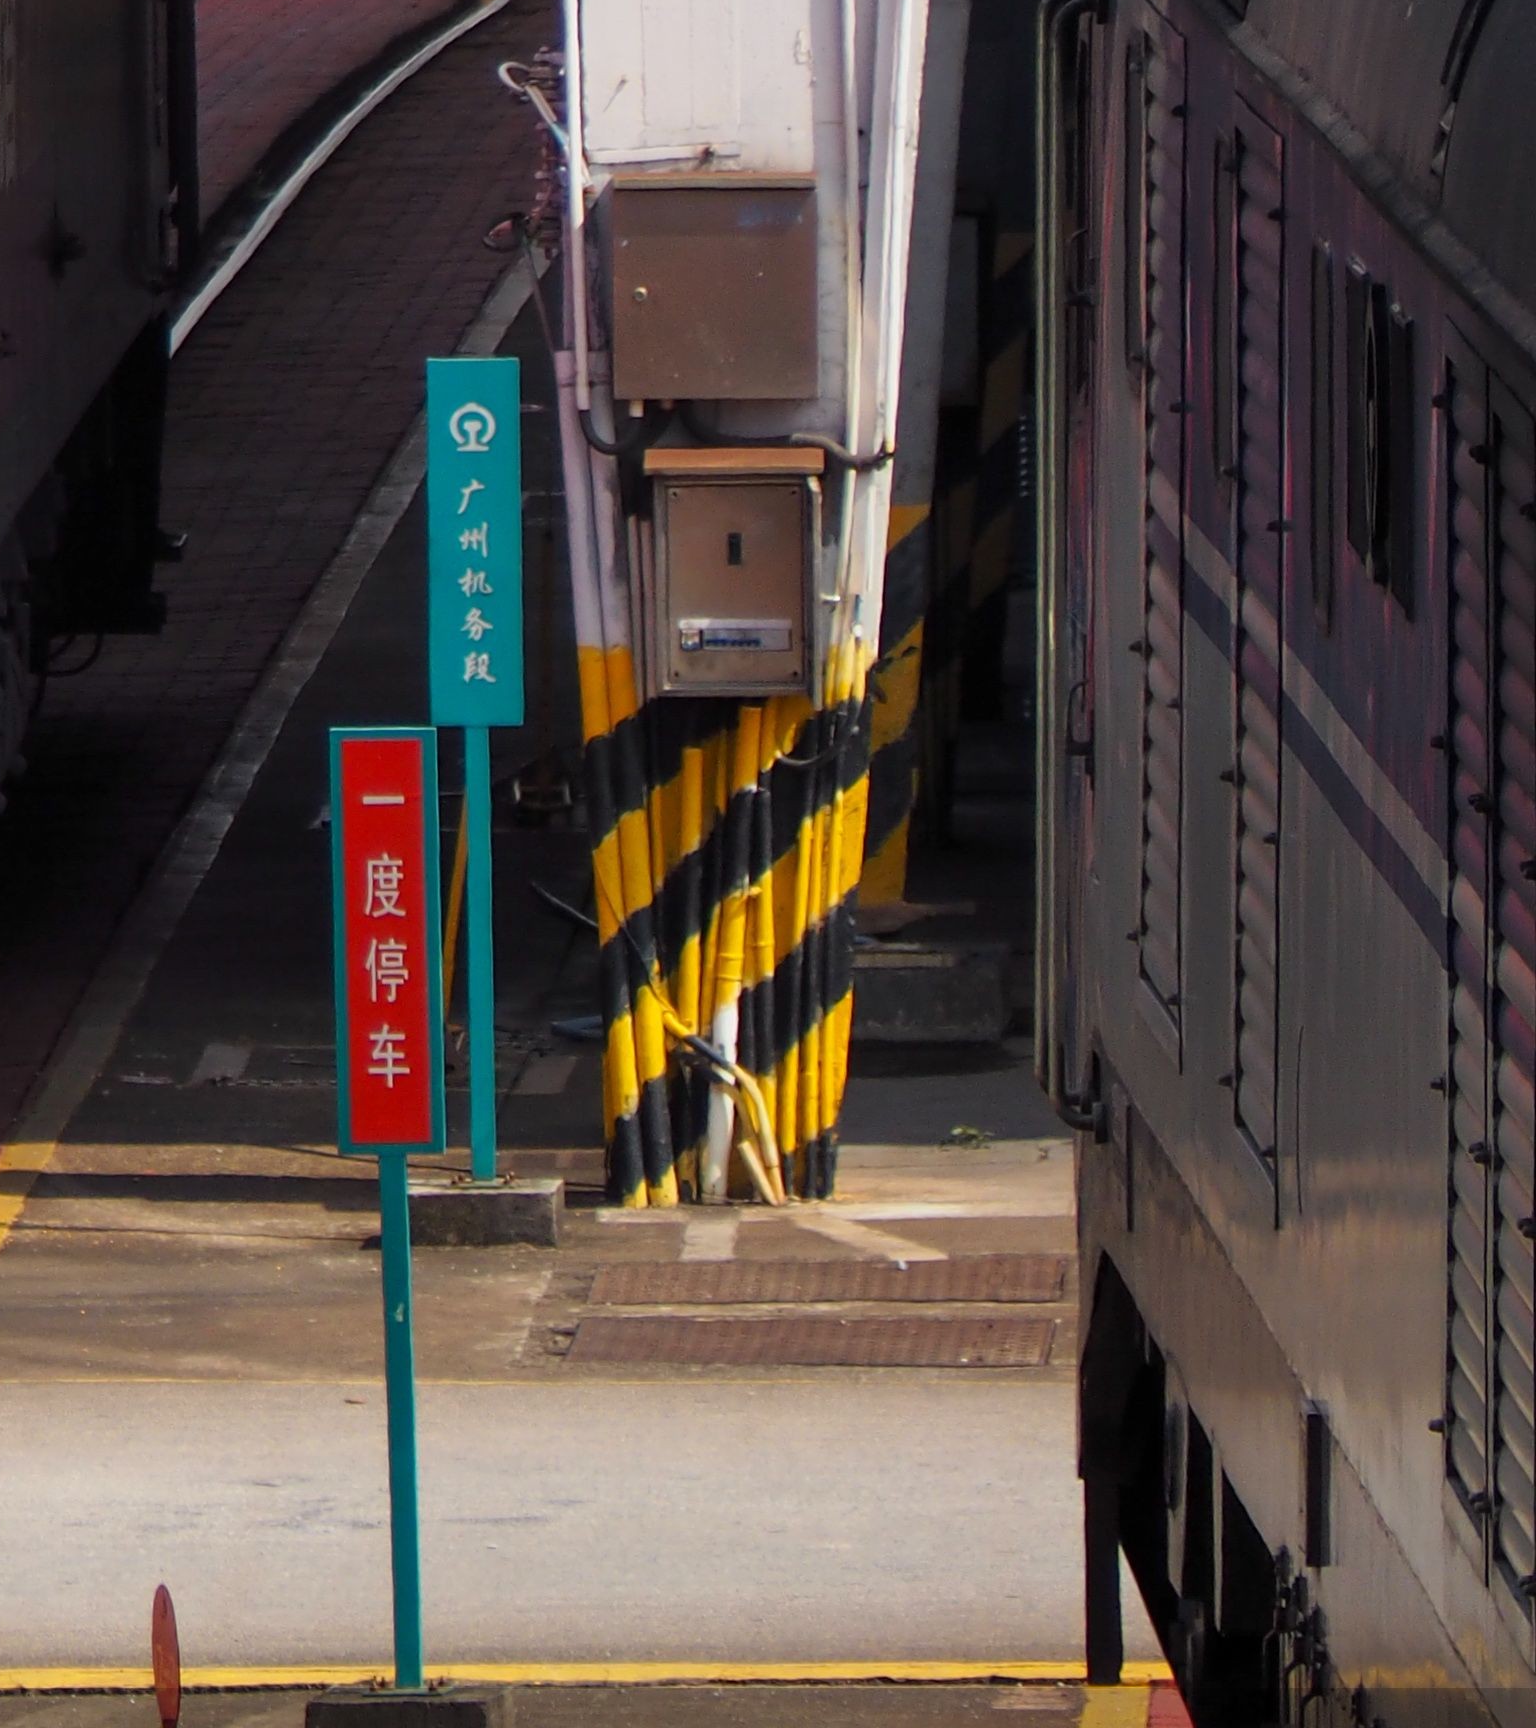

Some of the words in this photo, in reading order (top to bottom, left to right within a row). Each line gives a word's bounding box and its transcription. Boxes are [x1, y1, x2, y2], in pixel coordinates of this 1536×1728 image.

[457, 478, 497, 683] 广州机务段
[362, 794, 411, 1090] 一度停车
